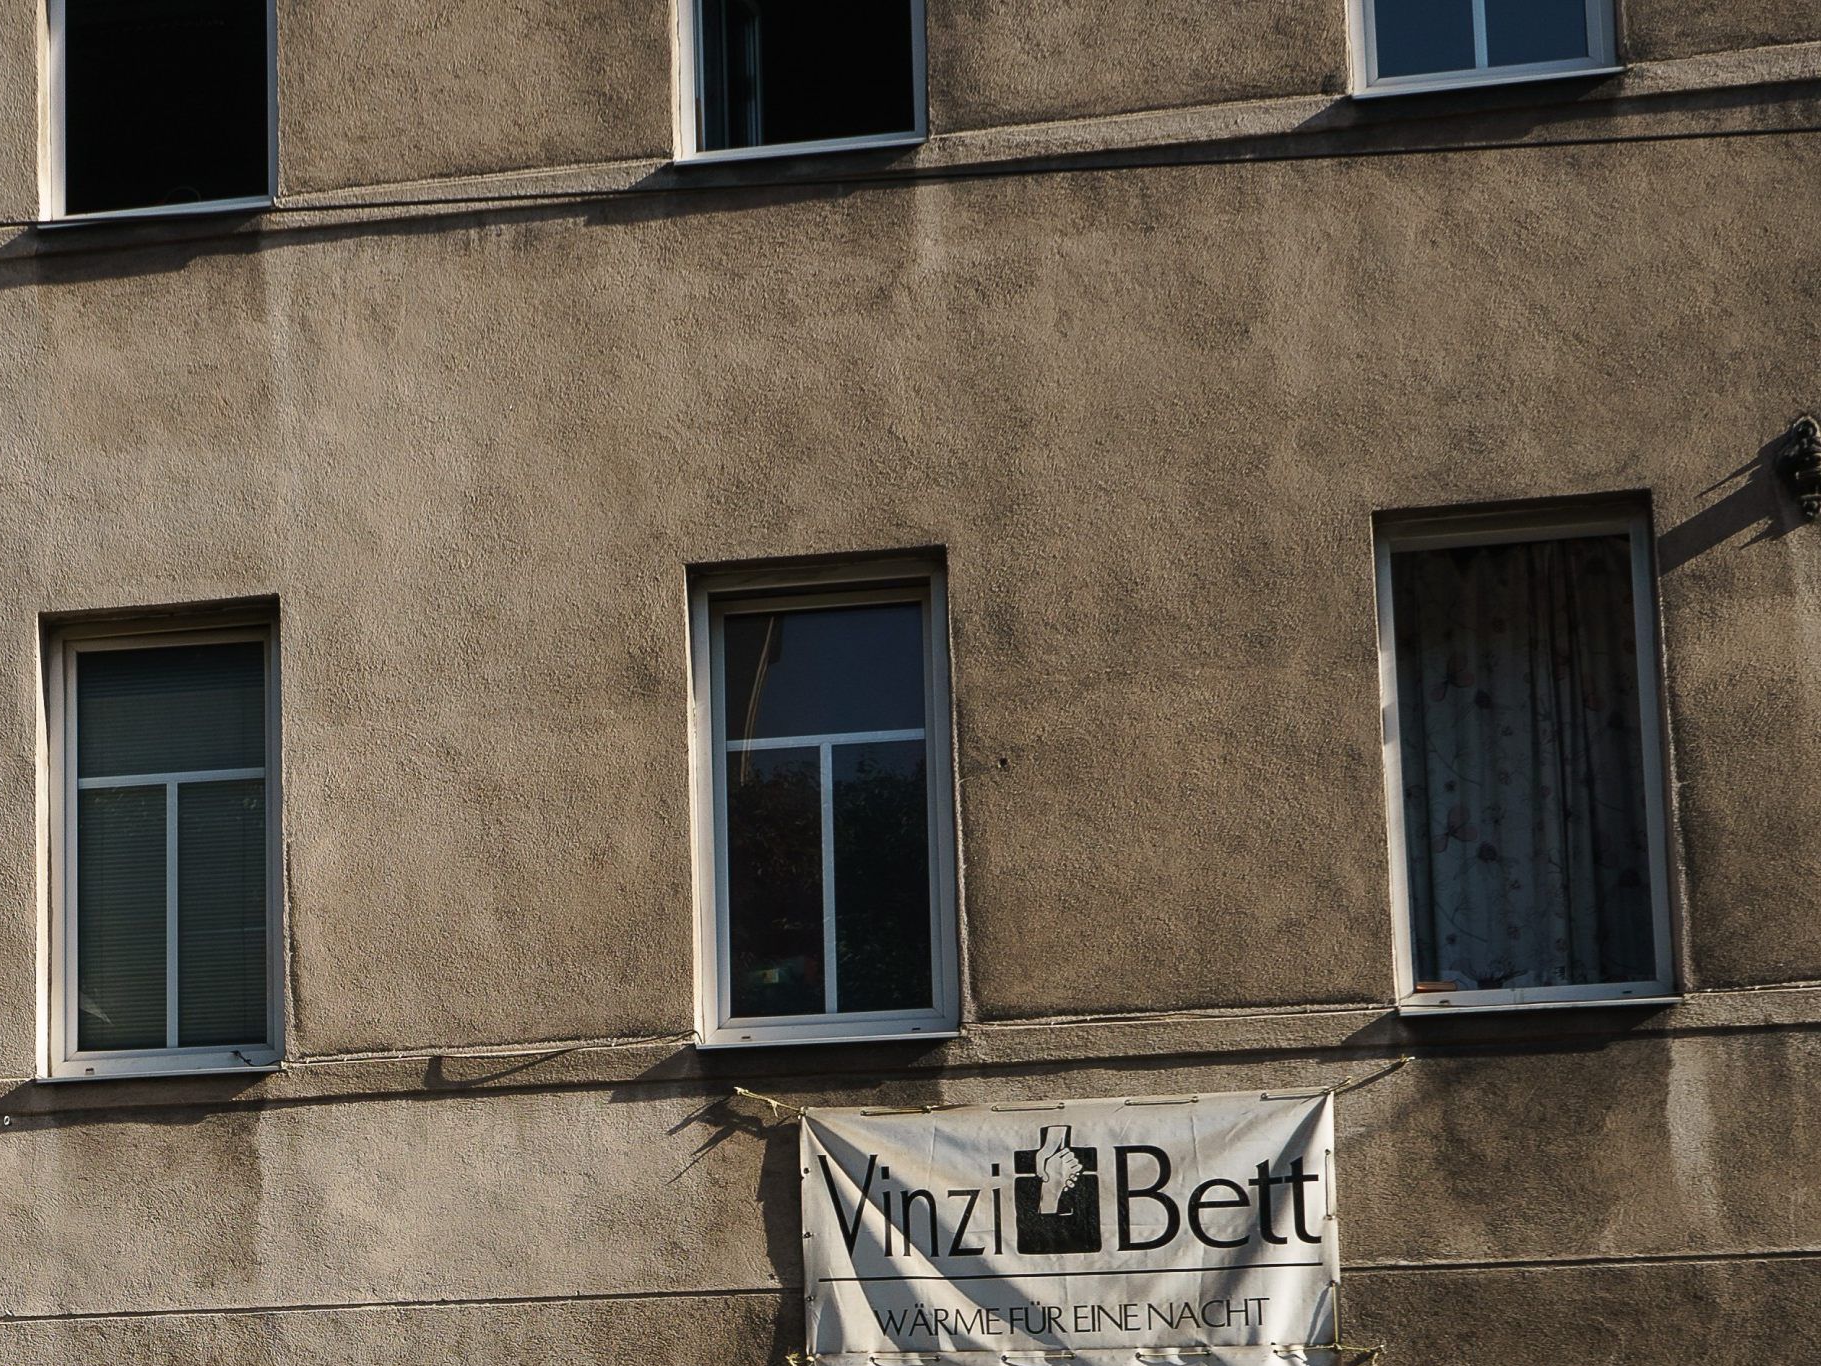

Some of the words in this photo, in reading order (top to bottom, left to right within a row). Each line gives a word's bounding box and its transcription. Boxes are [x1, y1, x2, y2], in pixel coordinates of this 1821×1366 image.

[817, 1153, 1003, 1258] Vinzi
[1113, 1144, 1323, 1253] Bett
[875, 1302, 1004, 1337] WÄRME
[1009, 1300, 1067, 1336] FÜR
[1073, 1303, 1143, 1333] EINE
[1147, 1297, 1271, 1331] NACHT
